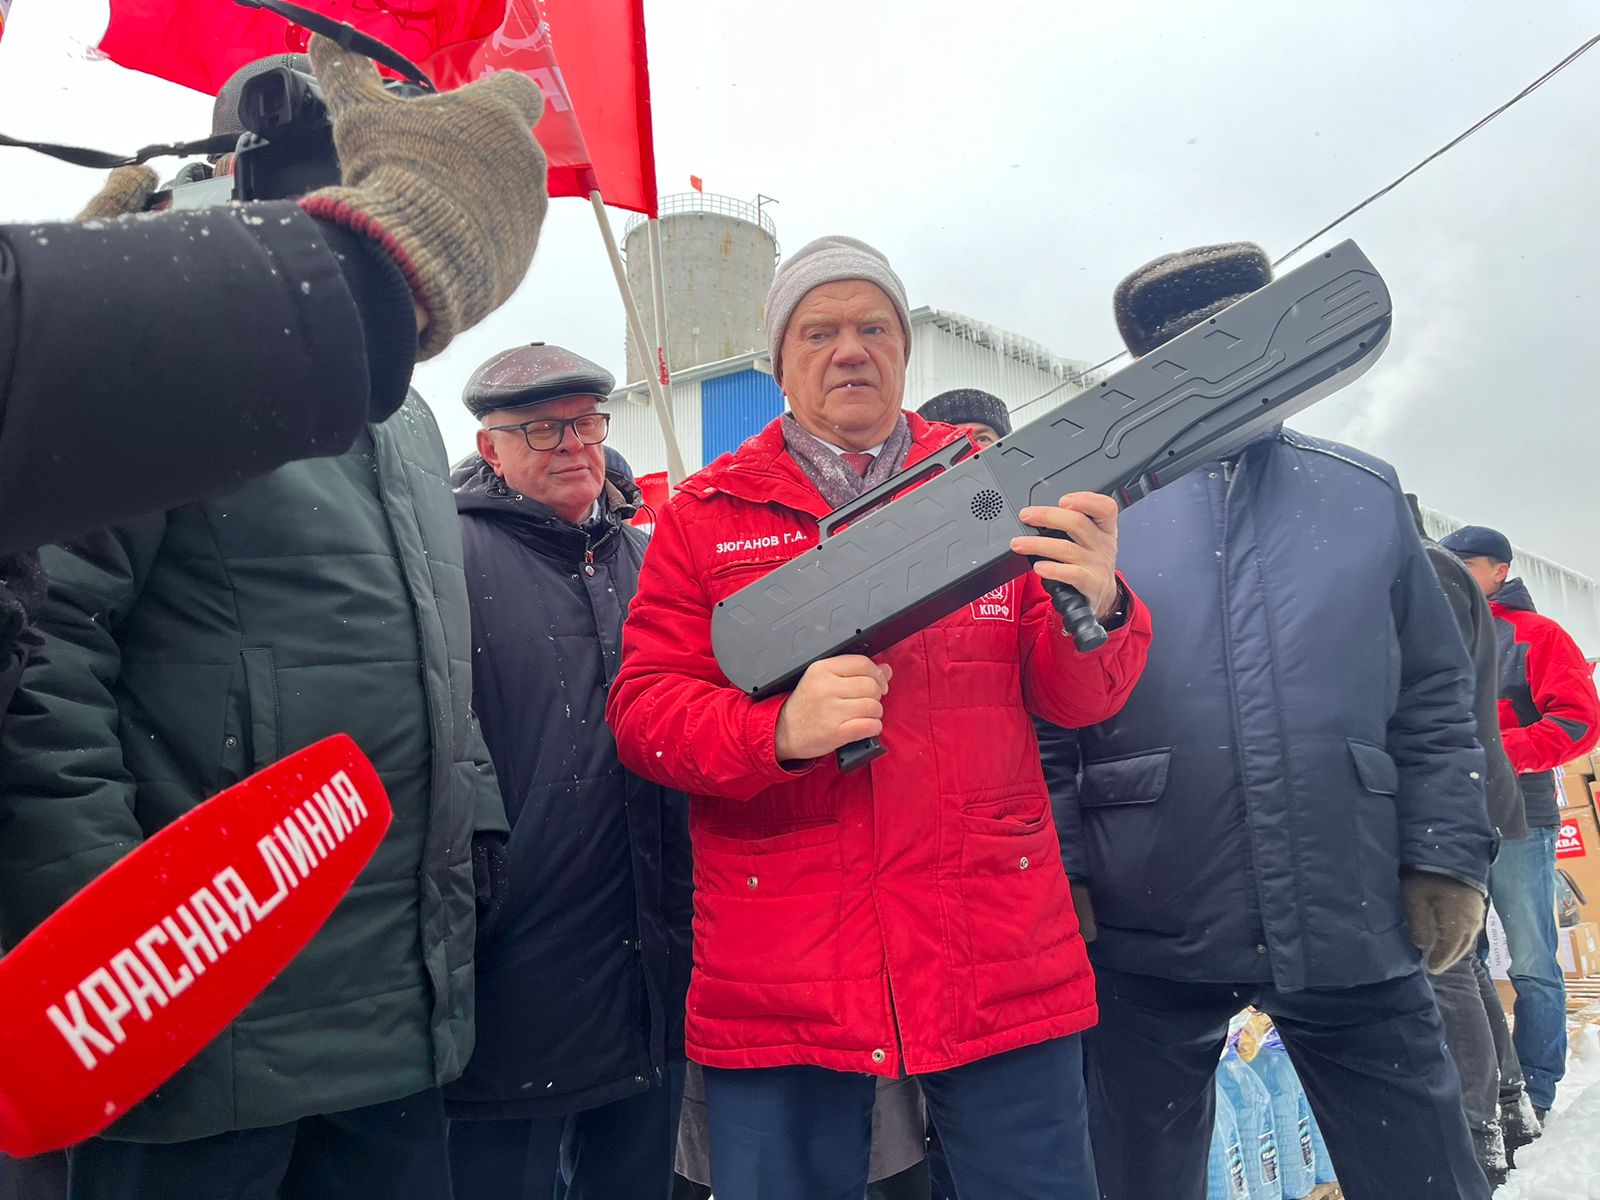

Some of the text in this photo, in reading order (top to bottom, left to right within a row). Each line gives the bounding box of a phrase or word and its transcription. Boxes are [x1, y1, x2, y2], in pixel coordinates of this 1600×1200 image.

[715, 530, 808, 553] ЗЮГАНОВ Г.А.
[979, 604, 1010, 618] КПРФ
[46, 770, 369, 1070] КРАСНАЯ ЛИНИЯ
